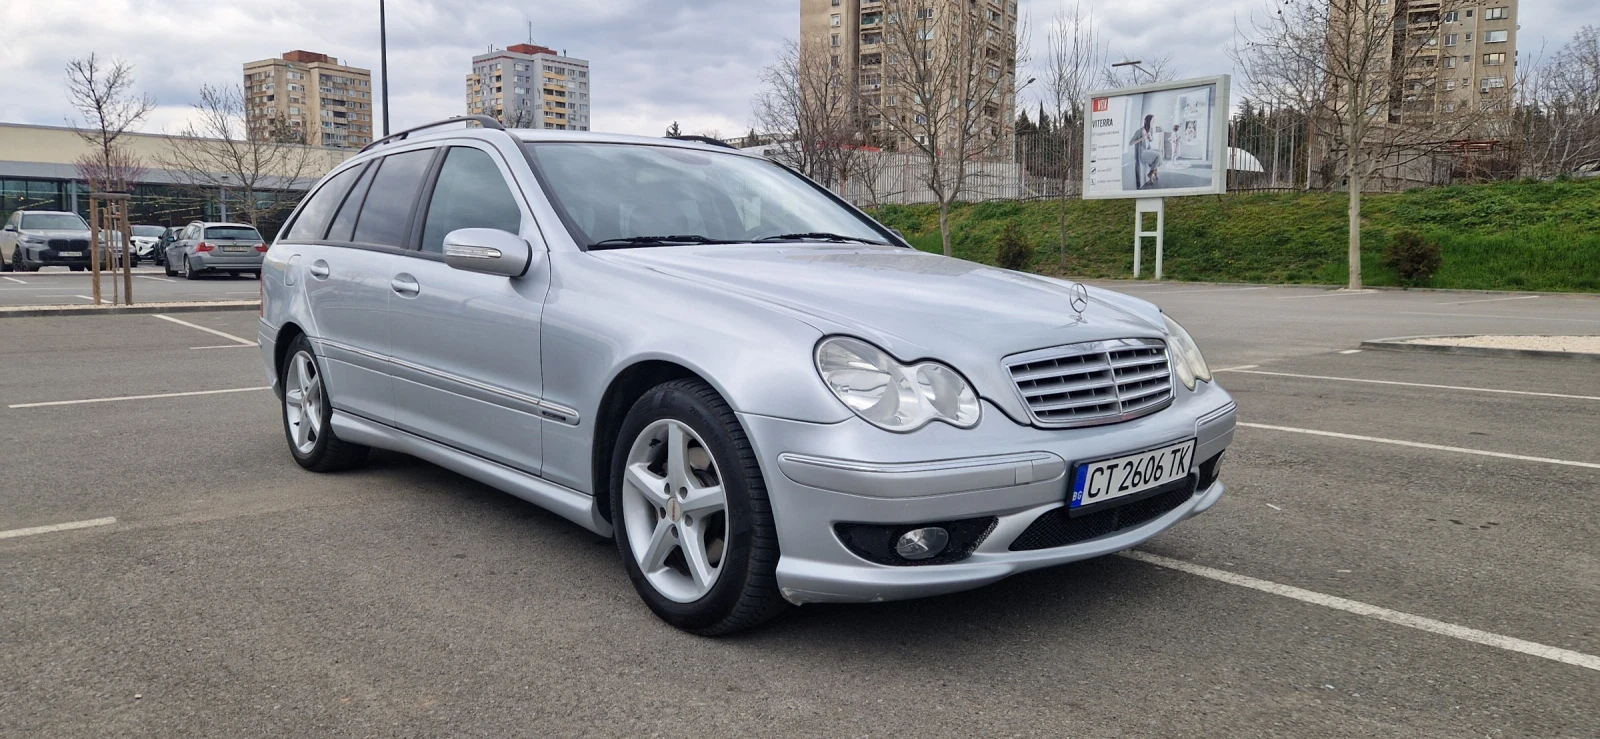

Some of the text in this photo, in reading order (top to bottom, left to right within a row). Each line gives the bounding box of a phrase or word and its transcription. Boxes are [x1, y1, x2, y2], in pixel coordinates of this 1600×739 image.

[1092, 118, 1113, 128] VITERRA
[1088, 445, 1191, 498] CT 2606 TK
[1072, 491, 1082, 501] BG
